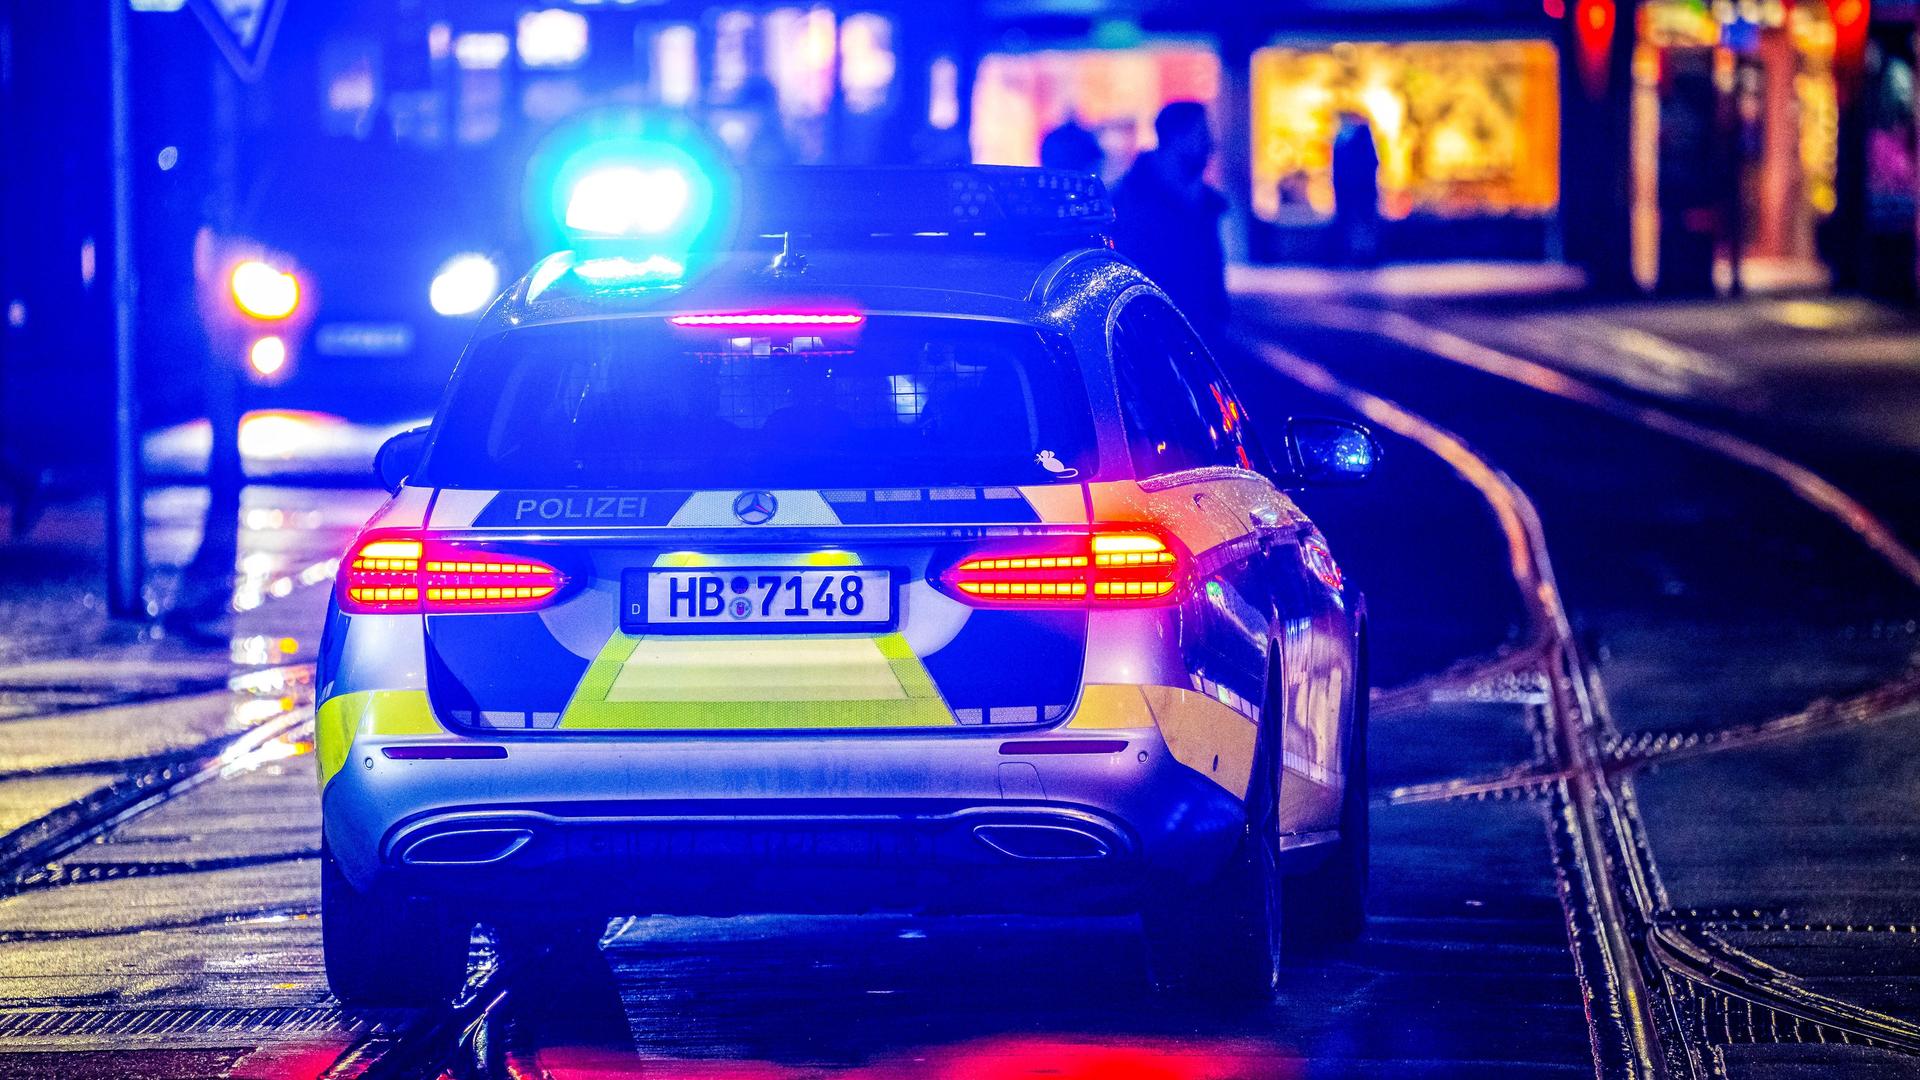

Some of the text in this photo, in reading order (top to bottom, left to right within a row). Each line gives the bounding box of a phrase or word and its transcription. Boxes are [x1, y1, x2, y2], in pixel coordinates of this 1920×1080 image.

[515, 497, 647, 520] POLIZEI
[669, 575, 864, 617] HB 7148
[631, 603, 641, 615] D
